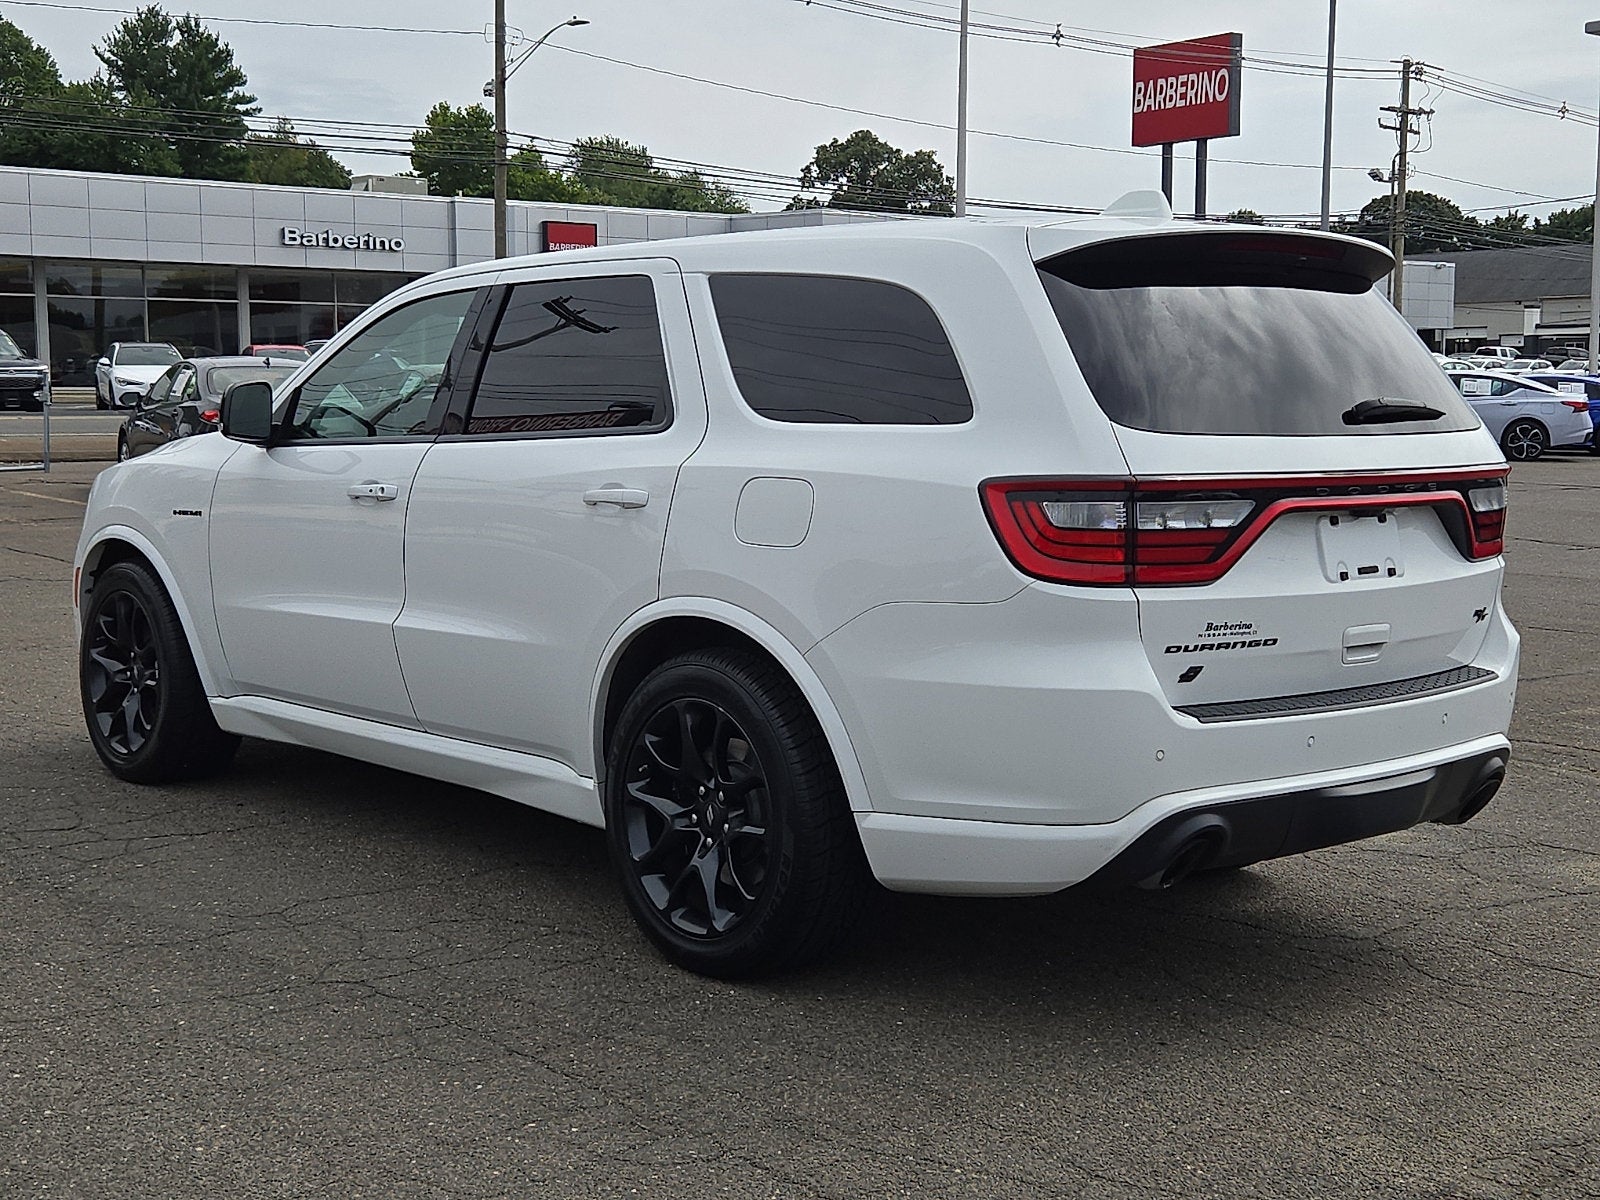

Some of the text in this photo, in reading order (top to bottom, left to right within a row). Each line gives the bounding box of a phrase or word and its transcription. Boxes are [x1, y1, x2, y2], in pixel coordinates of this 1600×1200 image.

[1133, 68, 1230, 114] BARBERINO
[281, 226, 405, 251] Barberino
[1315, 482, 1437, 496] DODGE
[1204, 620, 1253, 632] Barberino
[1163, 637, 1279, 654] DURANGO
